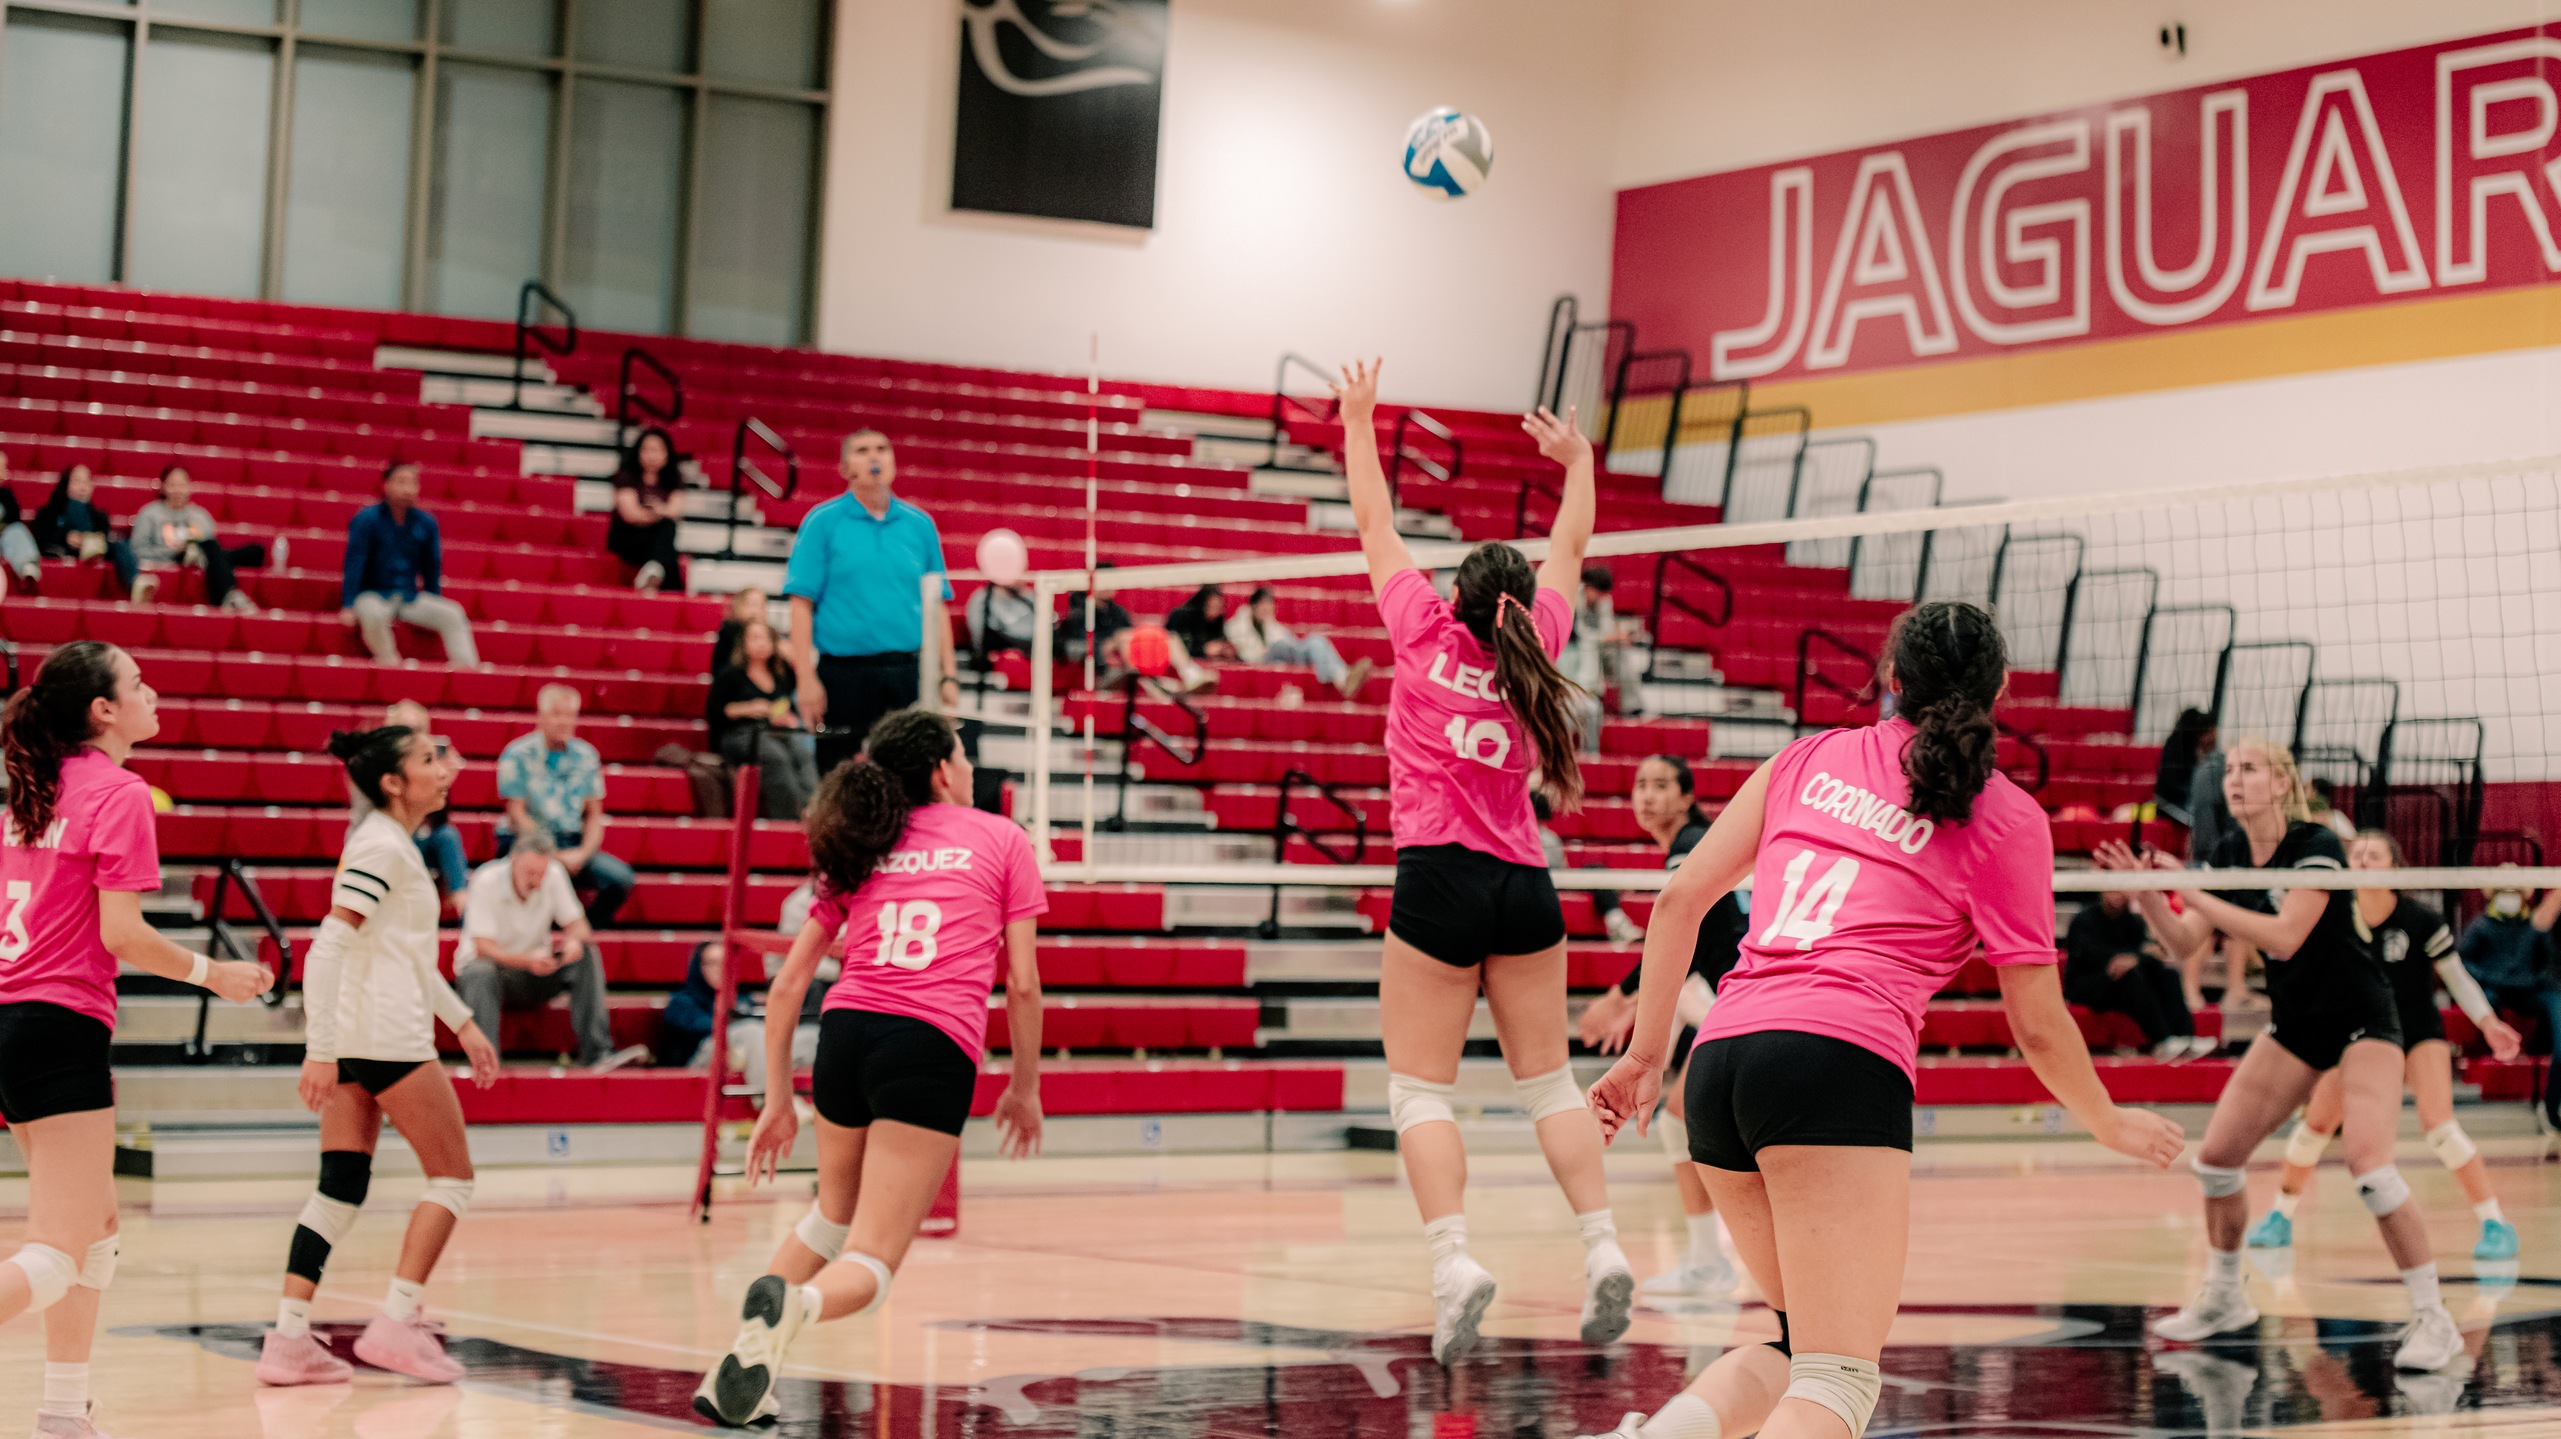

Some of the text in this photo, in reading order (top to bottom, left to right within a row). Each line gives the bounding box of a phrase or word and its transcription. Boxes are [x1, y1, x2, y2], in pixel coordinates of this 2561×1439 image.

[1444, 715, 1511, 769] 10
[1800, 772, 1935, 855] CORONADO
[0, 880, 32, 962] 3
[872, 899, 942, 971] 18
[1757, 849, 1861, 952] 14
